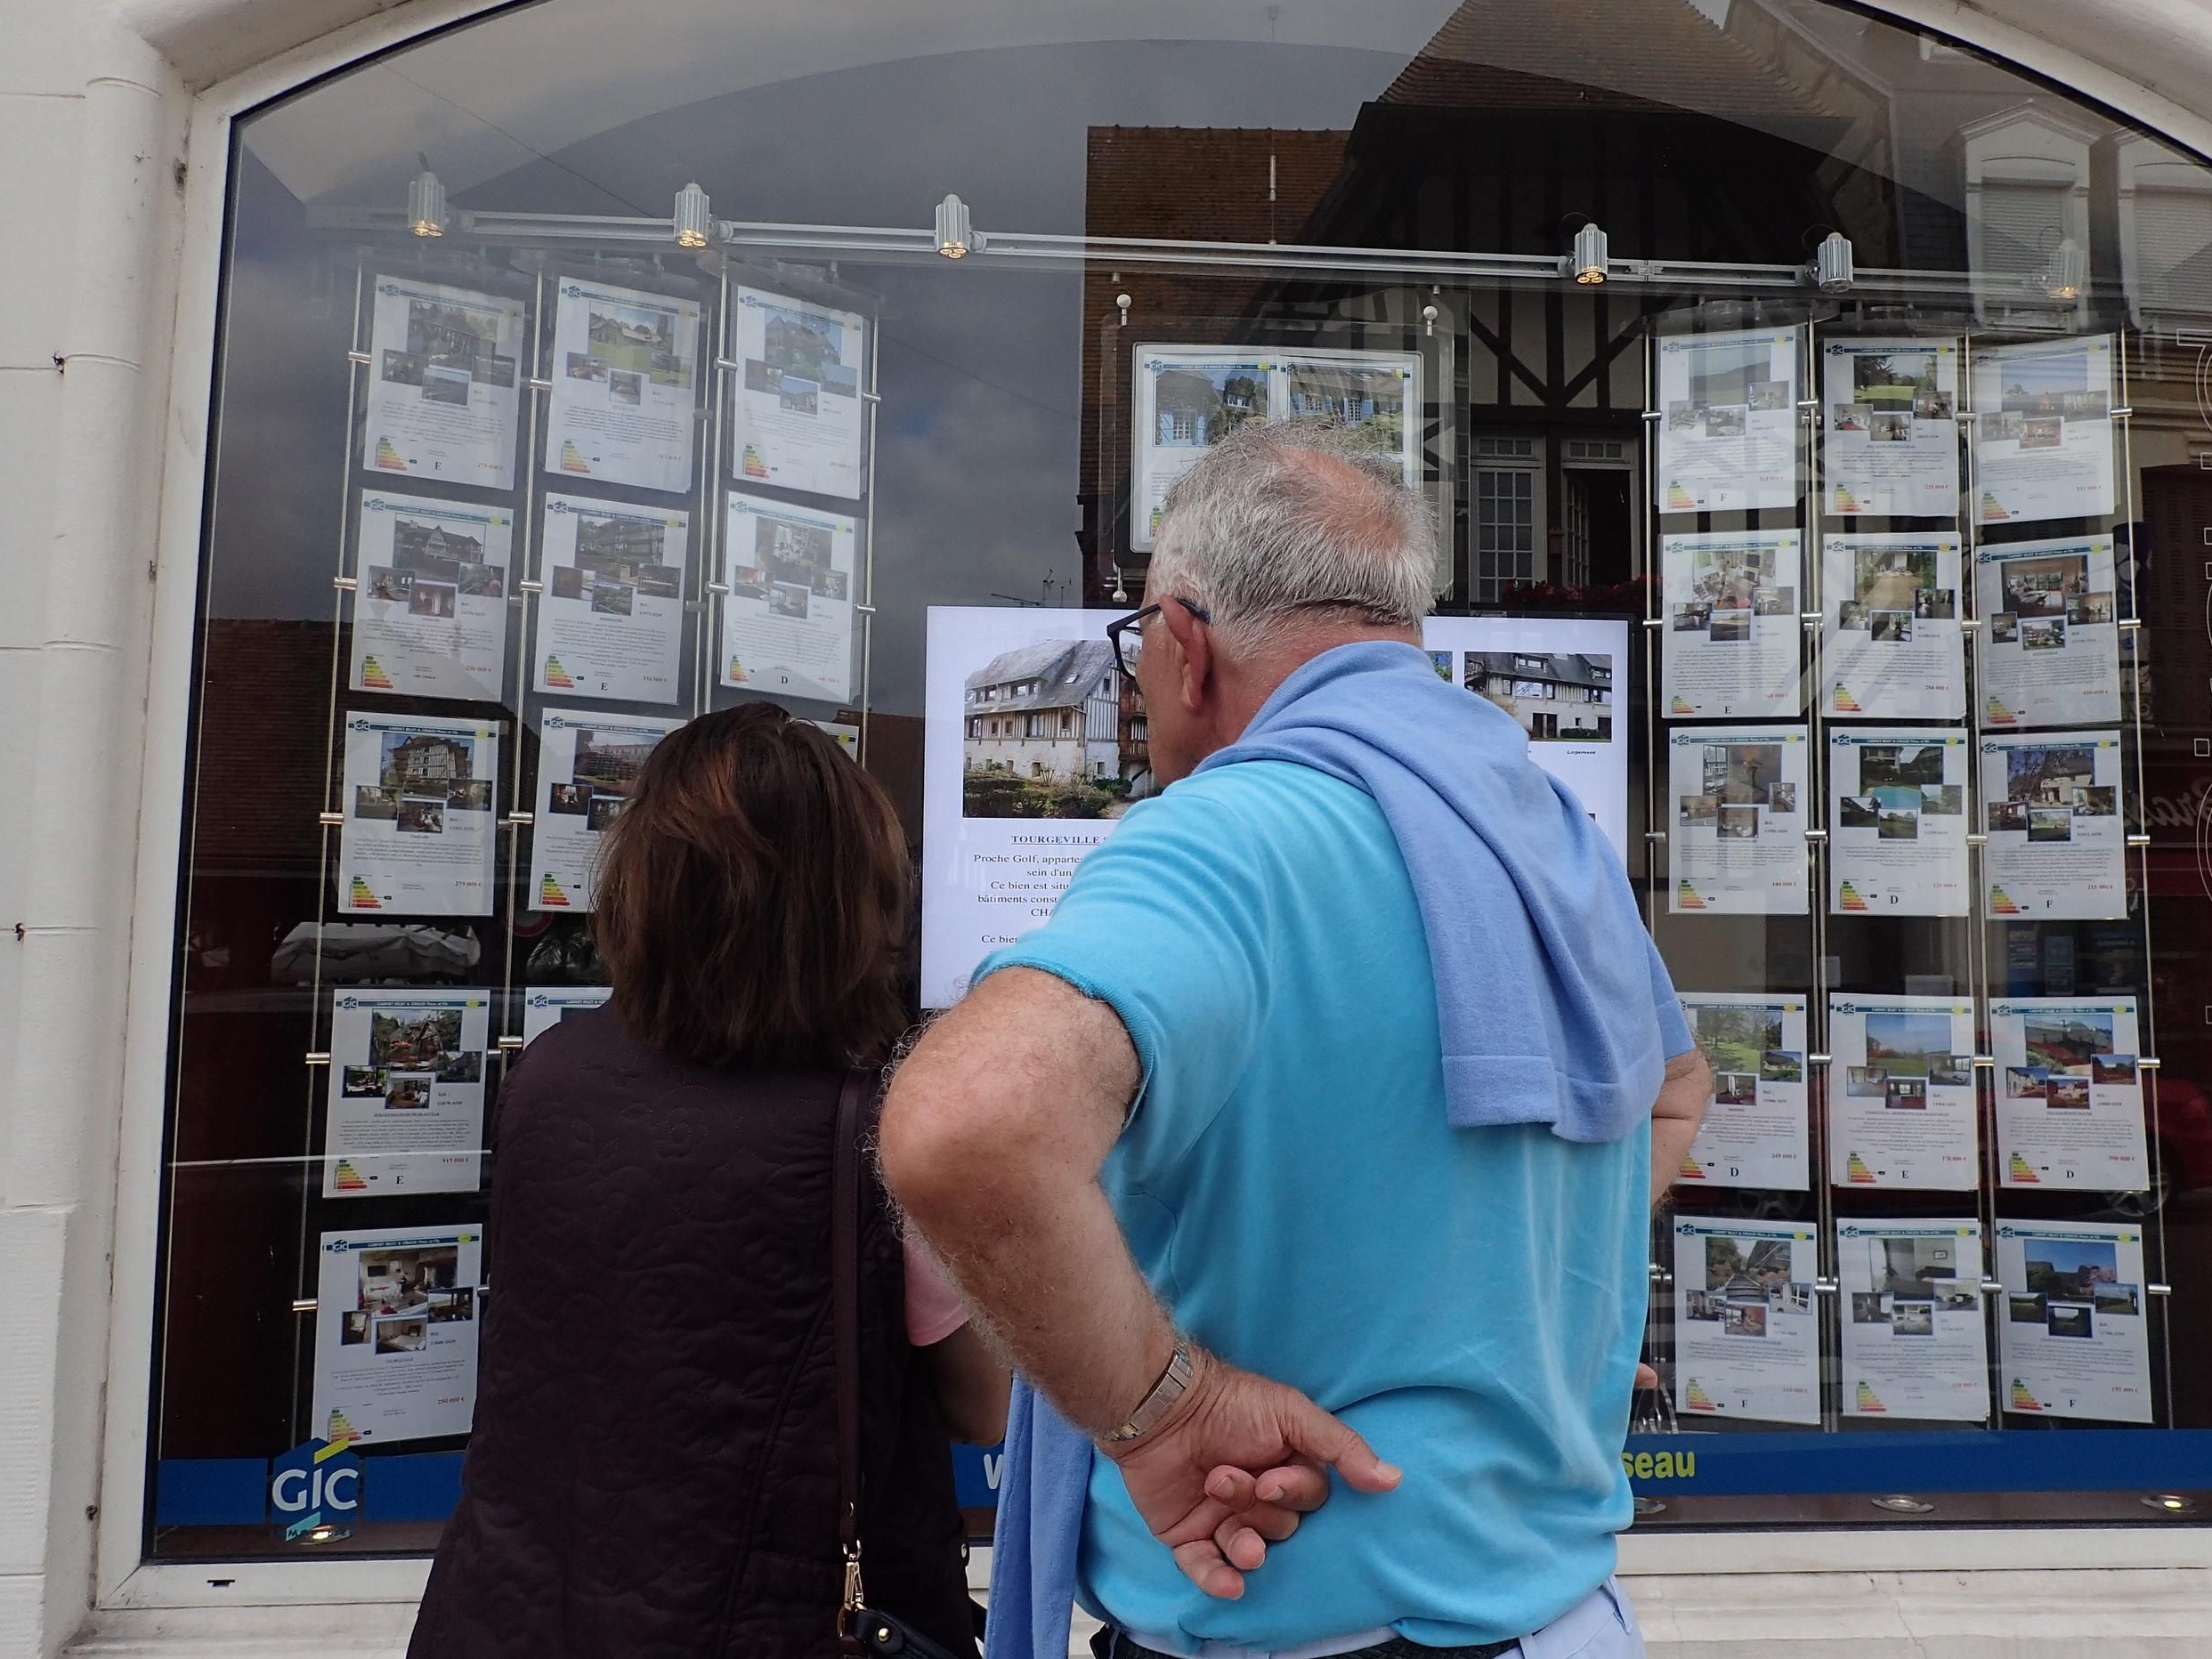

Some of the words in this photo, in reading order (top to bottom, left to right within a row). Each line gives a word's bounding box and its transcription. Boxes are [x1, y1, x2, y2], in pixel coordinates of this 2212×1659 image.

[781, 676, 788, 684] D
[601, 682, 608, 691] E
[1725, 706, 1731, 714] E
[1011, 836, 1100, 844] TOURGEVILLE
[974, 854, 1009, 862] Proche
[1013, 854, 1039, 863] Golf,
[1042, 856, 1082, 865] apparte
[1026, 869, 1047, 877] sein
[1050, 869, 1072, 877] d'un
[991, 881, 1005, 889] Ce
[1009, 881, 1030, 890] bien
[1033, 882, 1047, 890] est
[977, 894, 1027, 902] bâtiments
[1890, 895, 1898, 904] D
[981, 935, 995, 943] Ce
[1731, 1167, 1738, 1177] D
[2066, 1170, 2074, 1178] D
[396, 1176, 404, 1185] E
[271, 1468, 359, 1511] GIC
